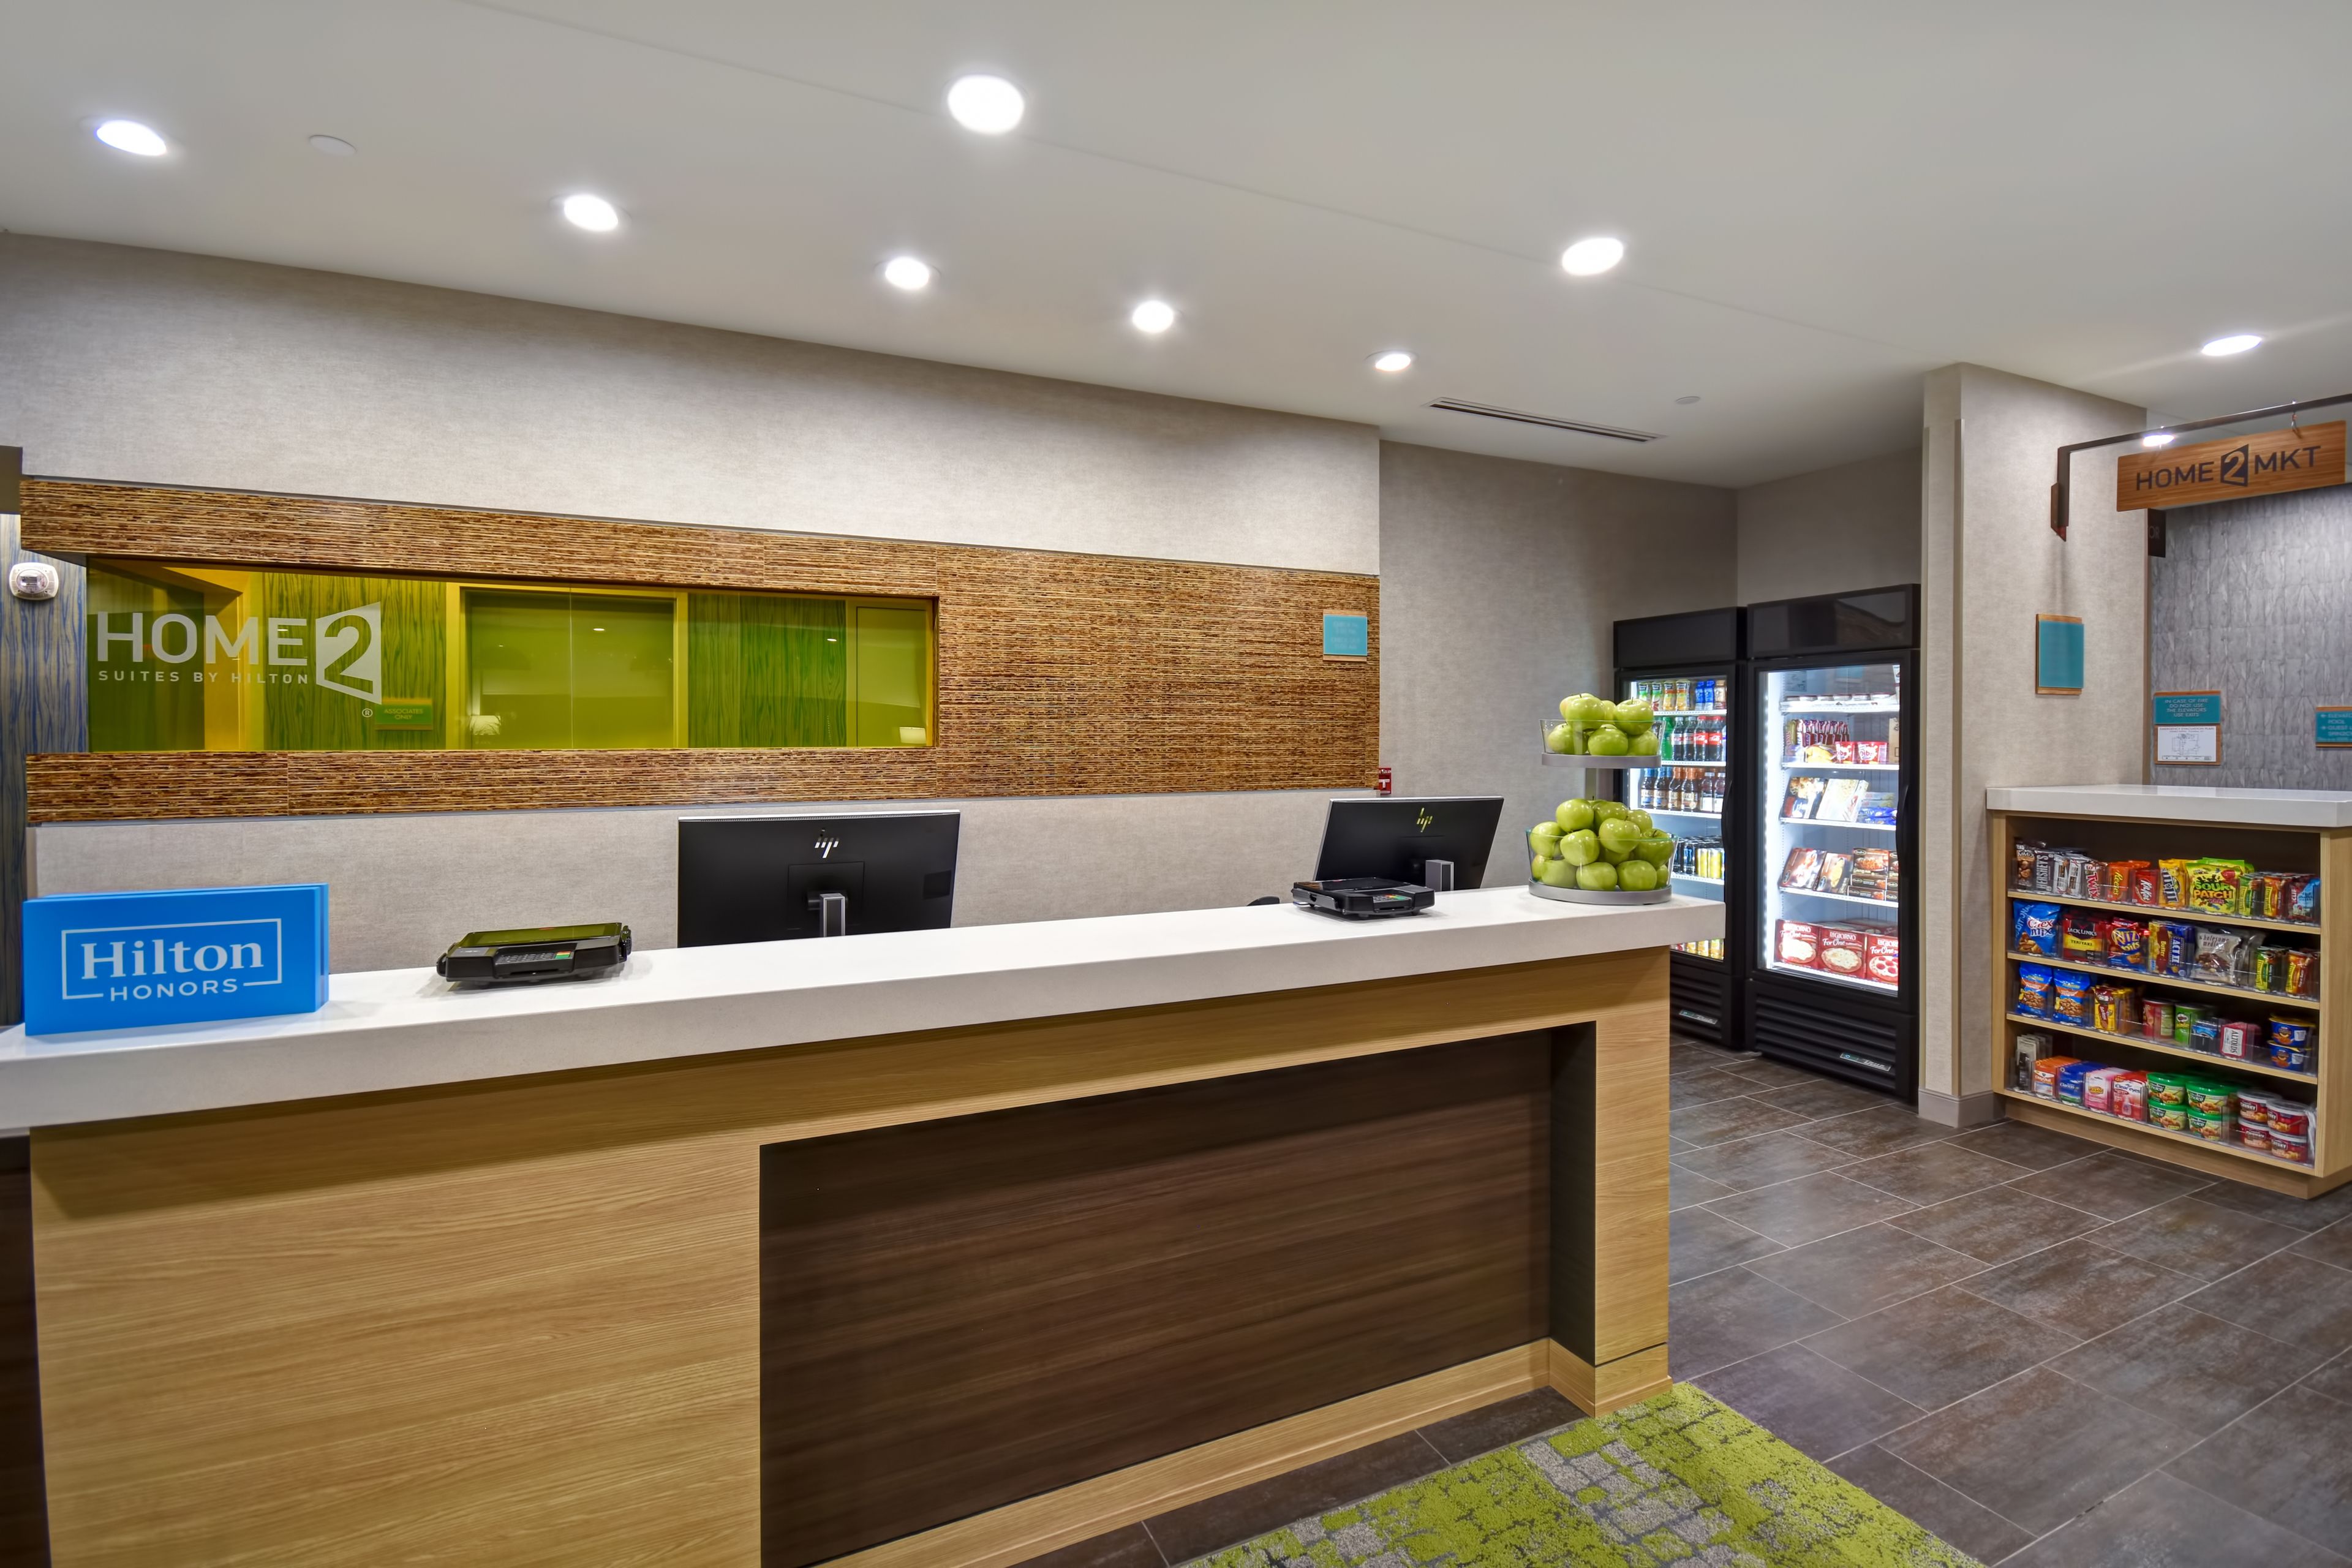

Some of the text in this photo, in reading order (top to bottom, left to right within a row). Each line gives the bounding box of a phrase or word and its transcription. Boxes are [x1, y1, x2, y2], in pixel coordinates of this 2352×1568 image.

[2136, 461, 2215, 491] HOME
[2254, 445, 2321, 475] MKT
[96, 611, 307, 666] HOME
[98, 670, 309, 685] SUITES BY HILTON
[2193, 889, 2233, 899] PATCH
[2194, 880, 2231, 891] SOUR
[1822, 938, 1833, 946] For
[1833, 938, 1845, 946] One
[2113, 930, 2138, 944] RITZ
[81, 938, 264, 980] Hilton
[110, 978, 238, 1002] HONORS
[2230, 1030, 2239, 1054] ALTOIDS
